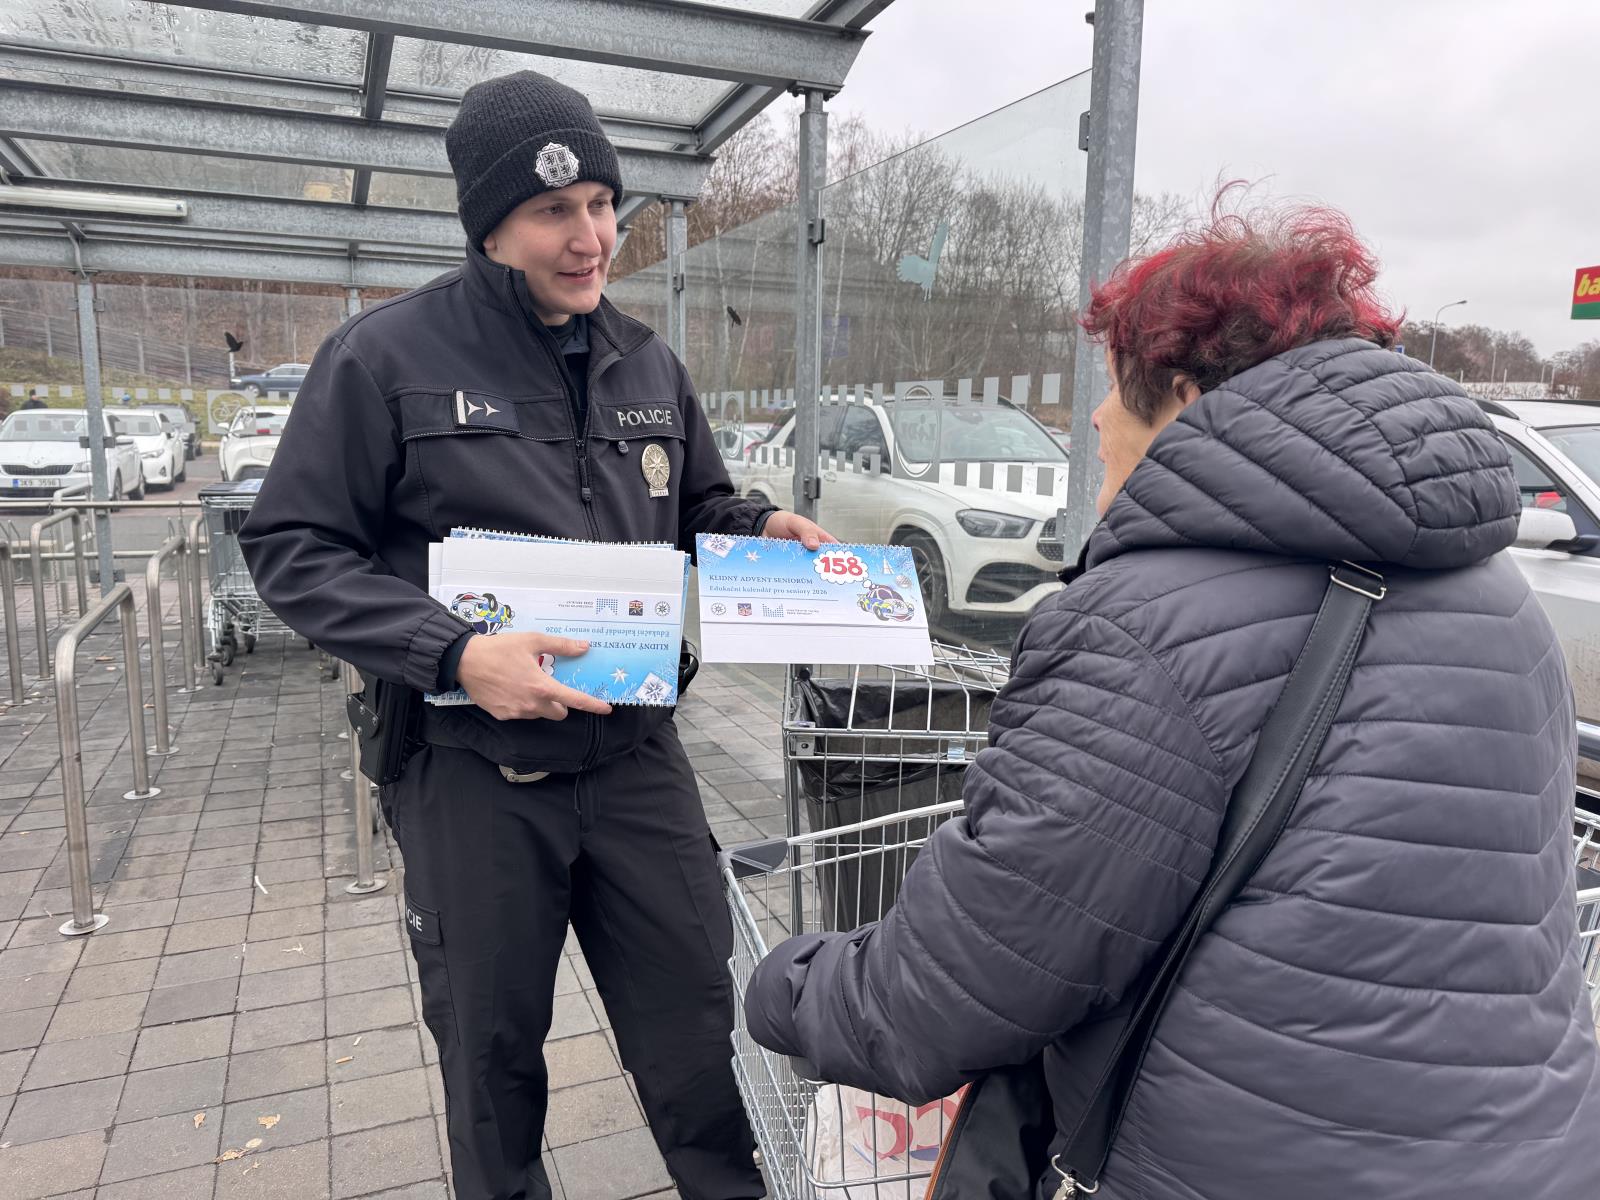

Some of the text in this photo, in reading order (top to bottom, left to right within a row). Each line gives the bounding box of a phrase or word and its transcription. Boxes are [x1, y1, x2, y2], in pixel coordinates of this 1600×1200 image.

[617, 409, 672, 426] POLICIE
[820, 556, 863, 576] 158
[709, 574, 813, 585] KLIDNÝ ADVENT SENIORŮM
[709, 585, 741, 593] Edukační
[786, 587, 810, 596] seniory
[545, 626, 670, 638] Edukační kalendář pro seniory 2026
[603, 641, 637, 649] ADVENT
[638, 641, 669, 651] KLIDNÝ
